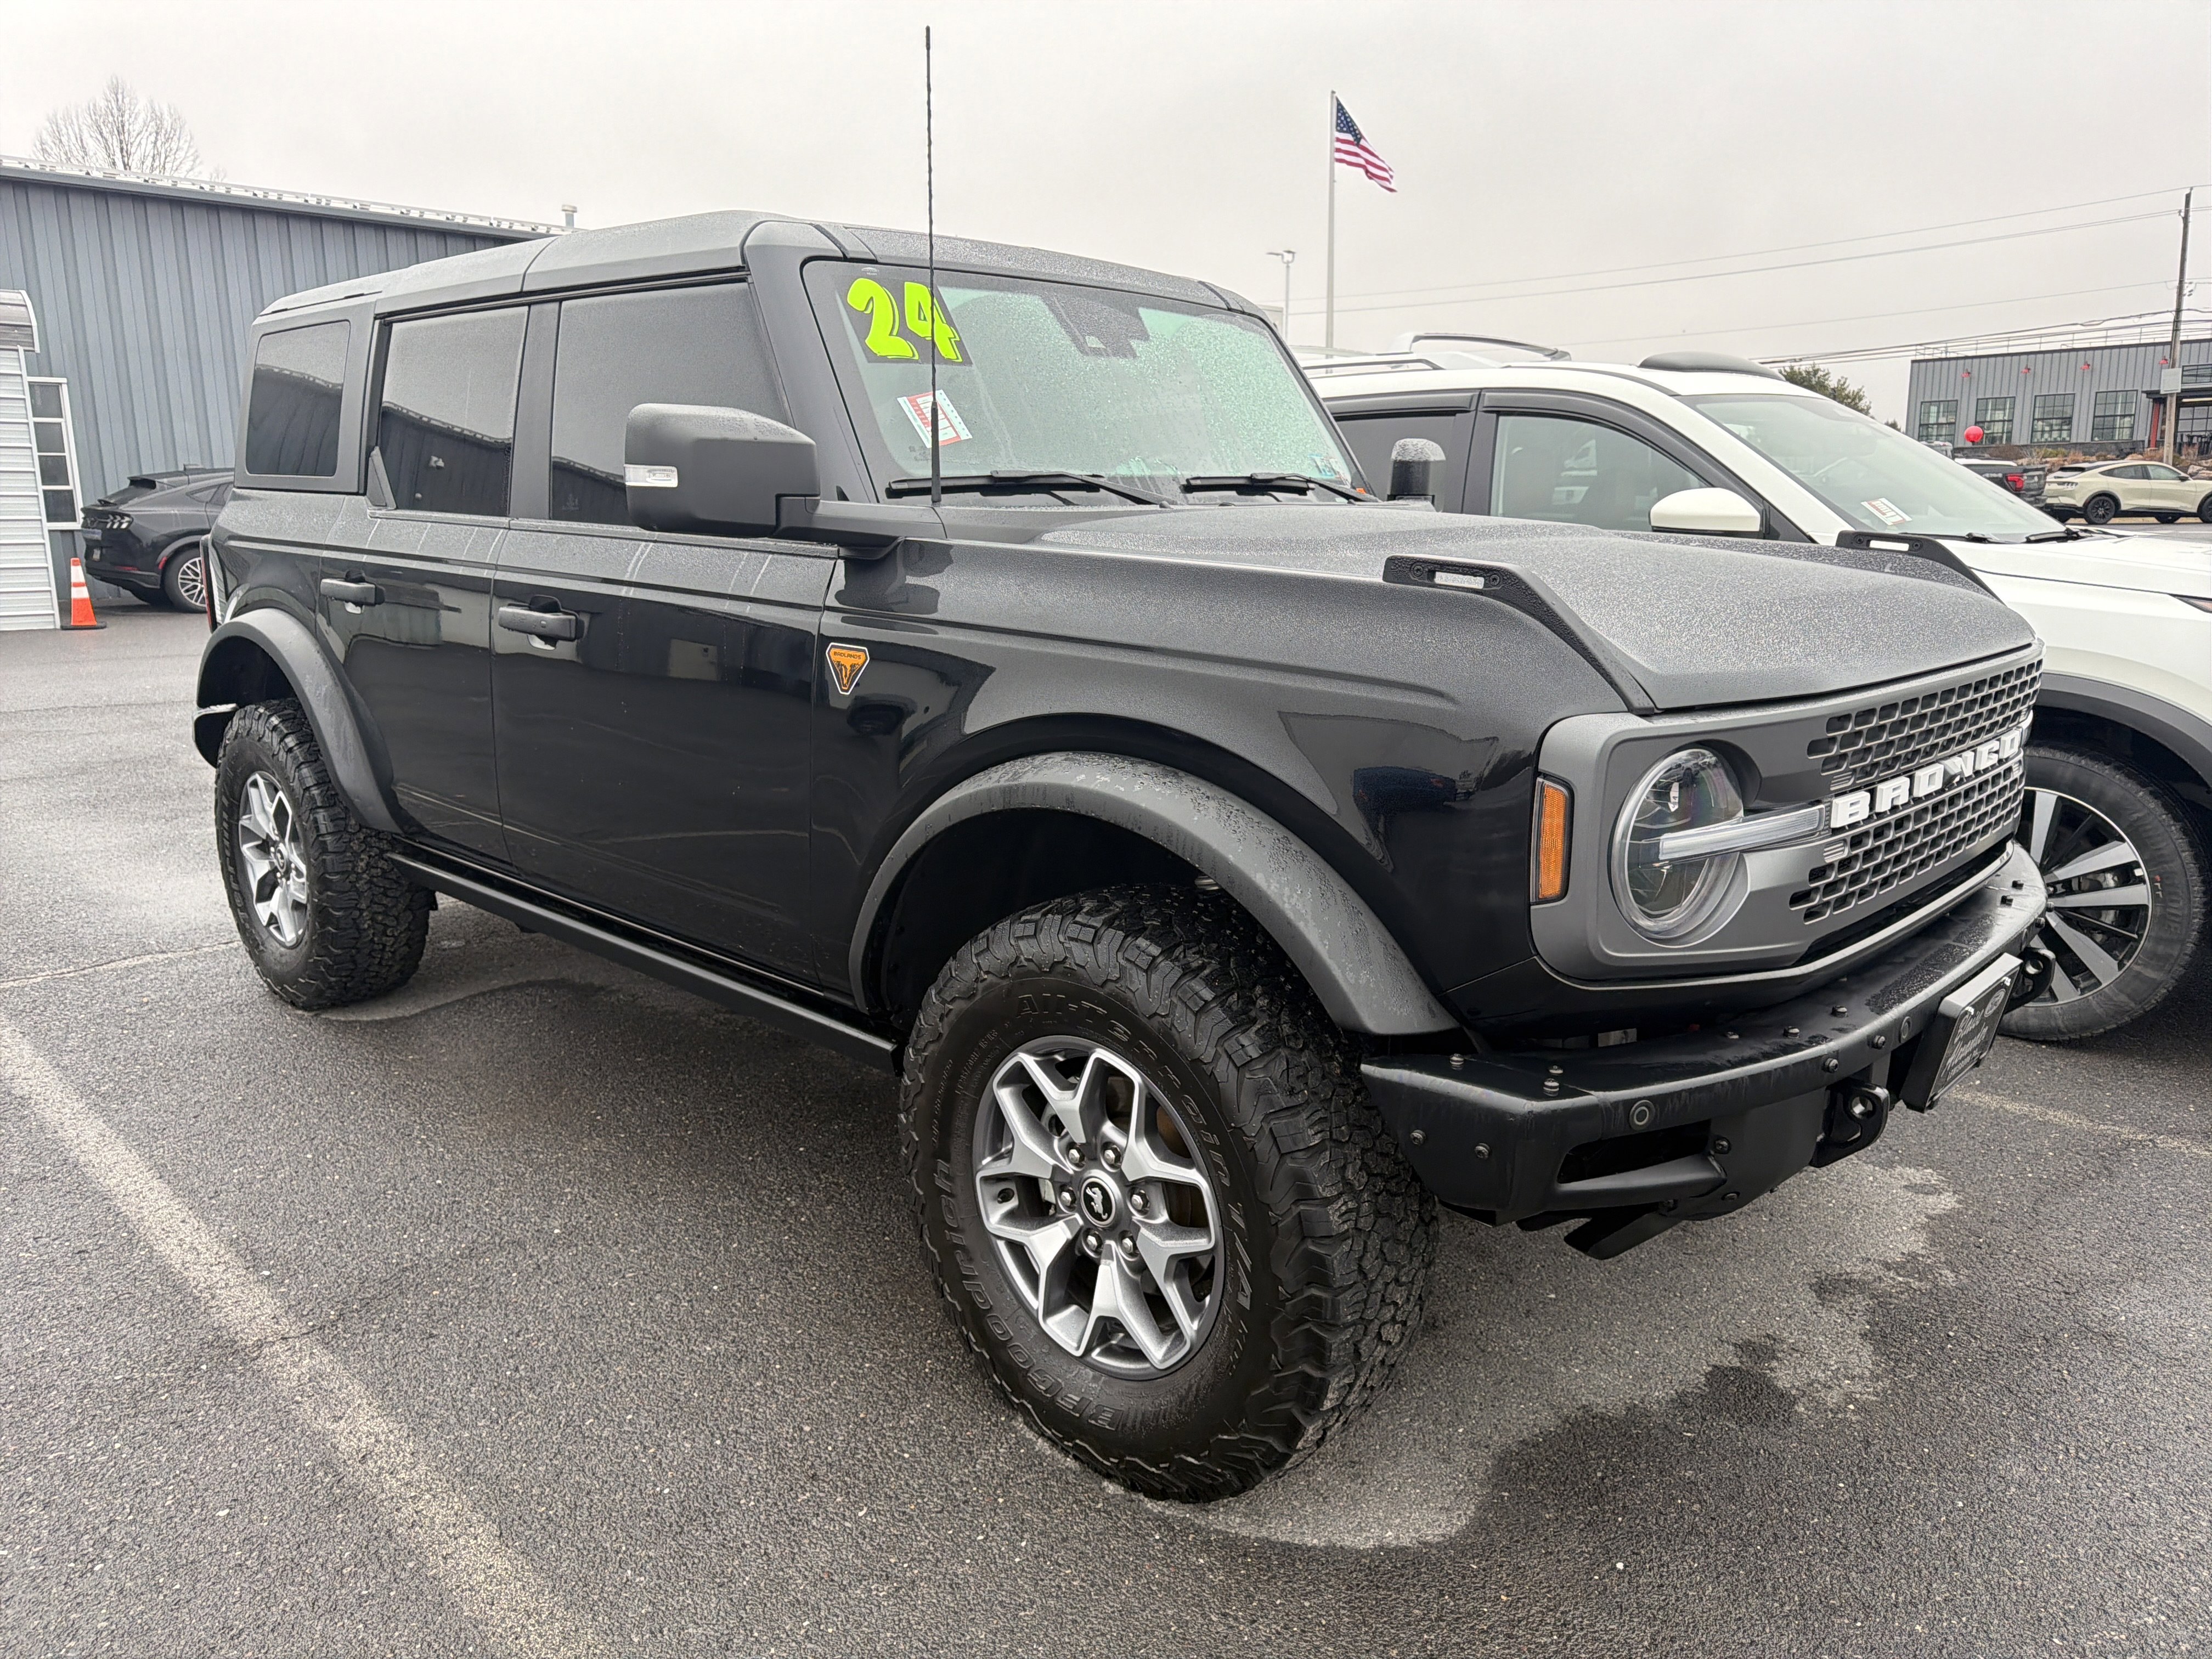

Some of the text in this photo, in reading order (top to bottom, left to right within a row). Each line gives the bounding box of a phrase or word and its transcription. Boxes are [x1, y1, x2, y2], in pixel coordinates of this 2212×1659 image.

[847, 278, 962, 362] 24
[833, 651, 862, 660] BADLANDS
[1831, 727, 2021, 828] BRONCO
[934, 1159, 1122, 1431] BFGoodrich
